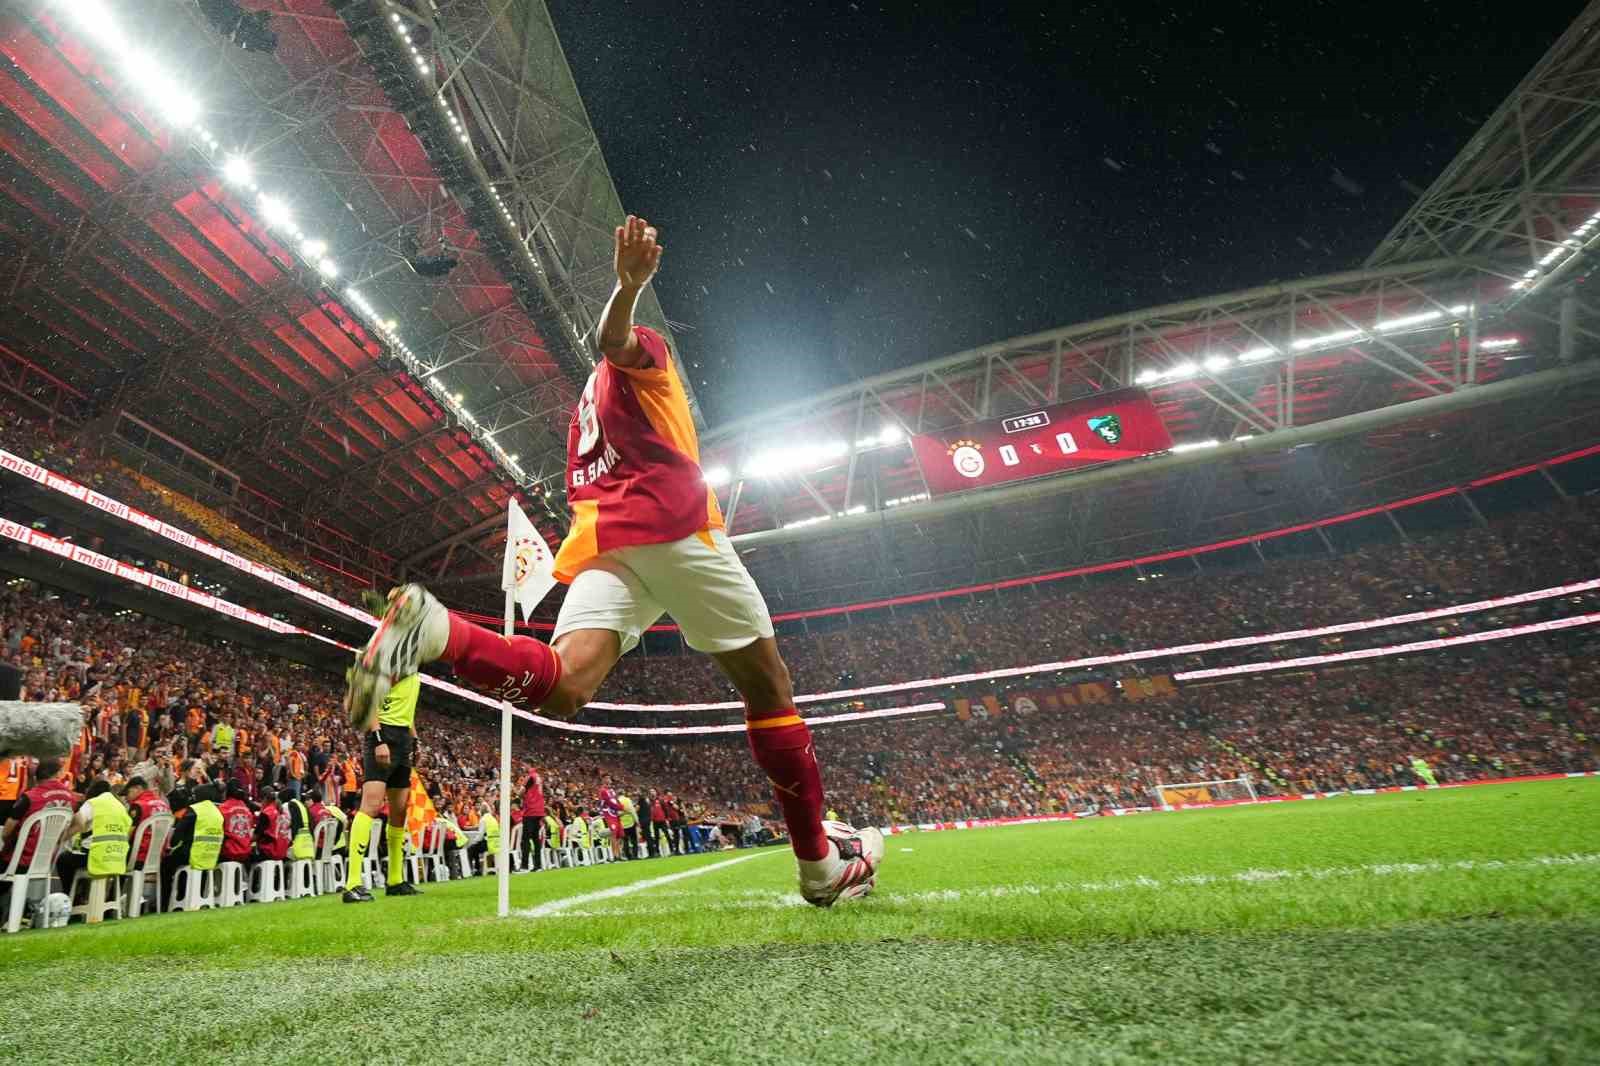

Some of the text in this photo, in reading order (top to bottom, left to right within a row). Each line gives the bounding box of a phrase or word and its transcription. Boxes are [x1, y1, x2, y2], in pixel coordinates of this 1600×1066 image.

[999, 432, 1078, 467] 0 0
[0, 454, 43, 481] misli
[91, 494, 126, 516] misli
[0, 520, 24, 541] isli
[165, 527, 193, 546] misli
[77, 550, 113, 572] misli
[155, 579, 184, 597] misli
